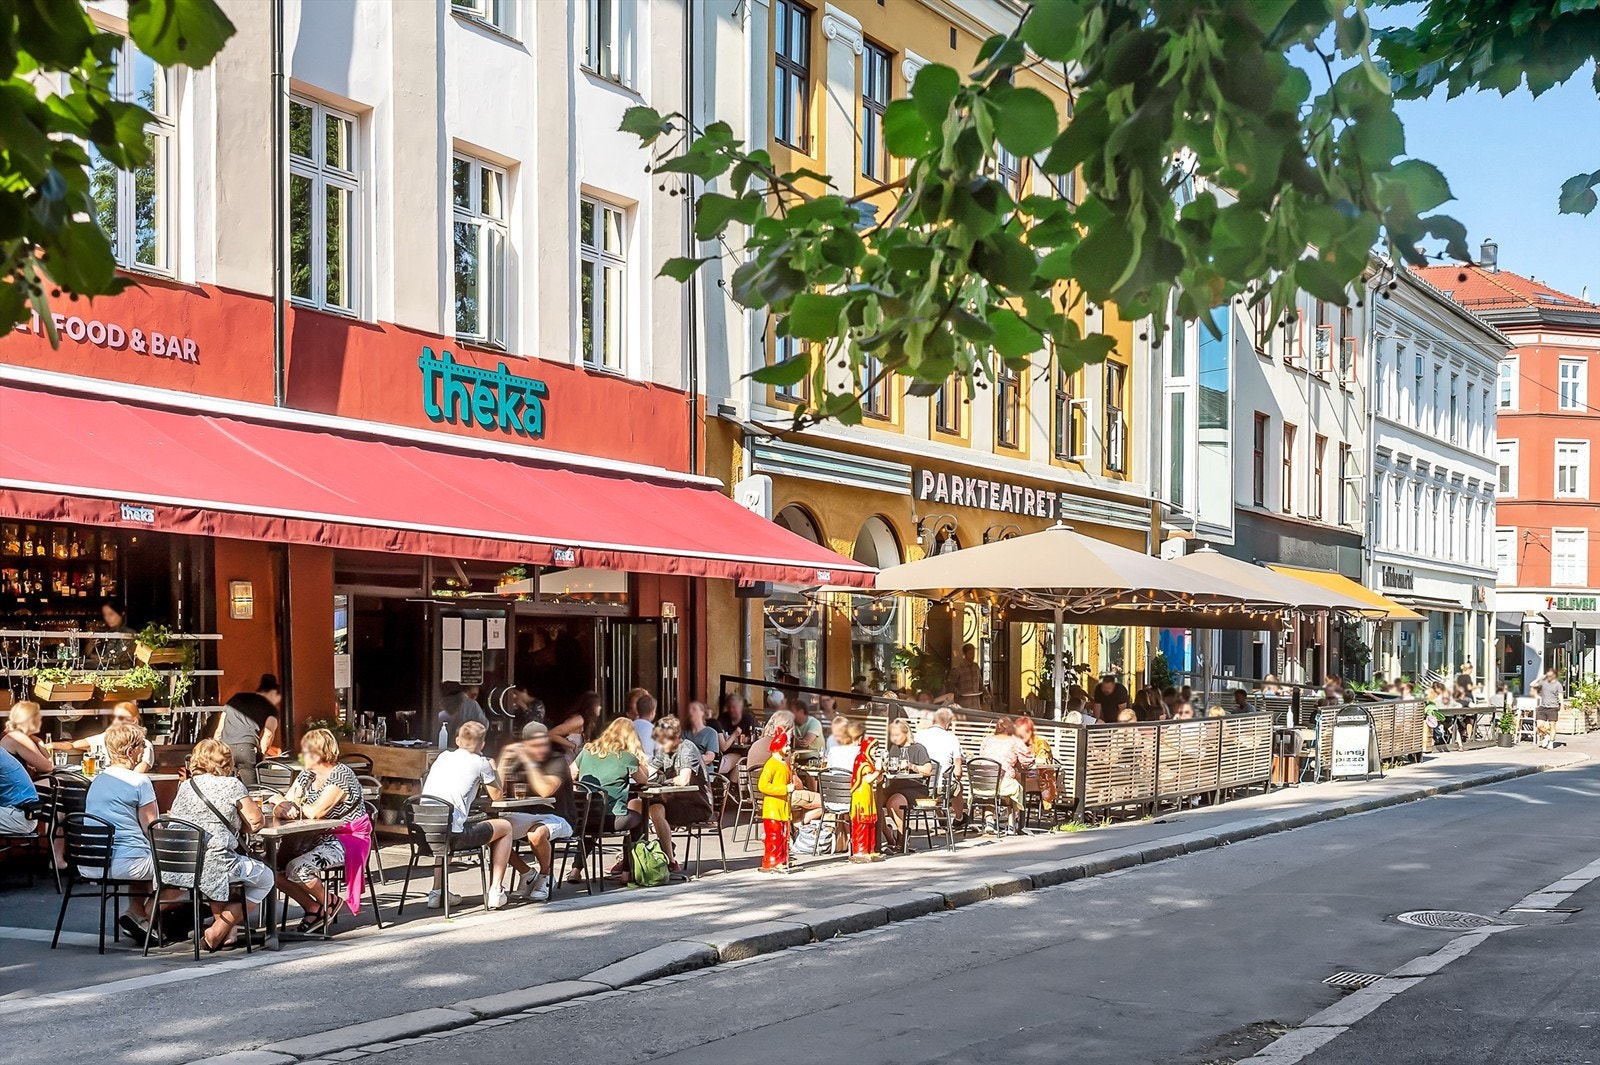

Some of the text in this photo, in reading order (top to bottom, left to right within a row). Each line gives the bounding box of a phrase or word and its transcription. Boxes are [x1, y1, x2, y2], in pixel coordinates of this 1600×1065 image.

[50, 312, 125, 347] FOOD
[130, 328, 147, 353] &
[151, 332, 198, 362] BAR
[417, 346, 546, 435] theka
[120, 503, 155, 523] theka
[919, 469, 1057, 519] PARKTEATRET
